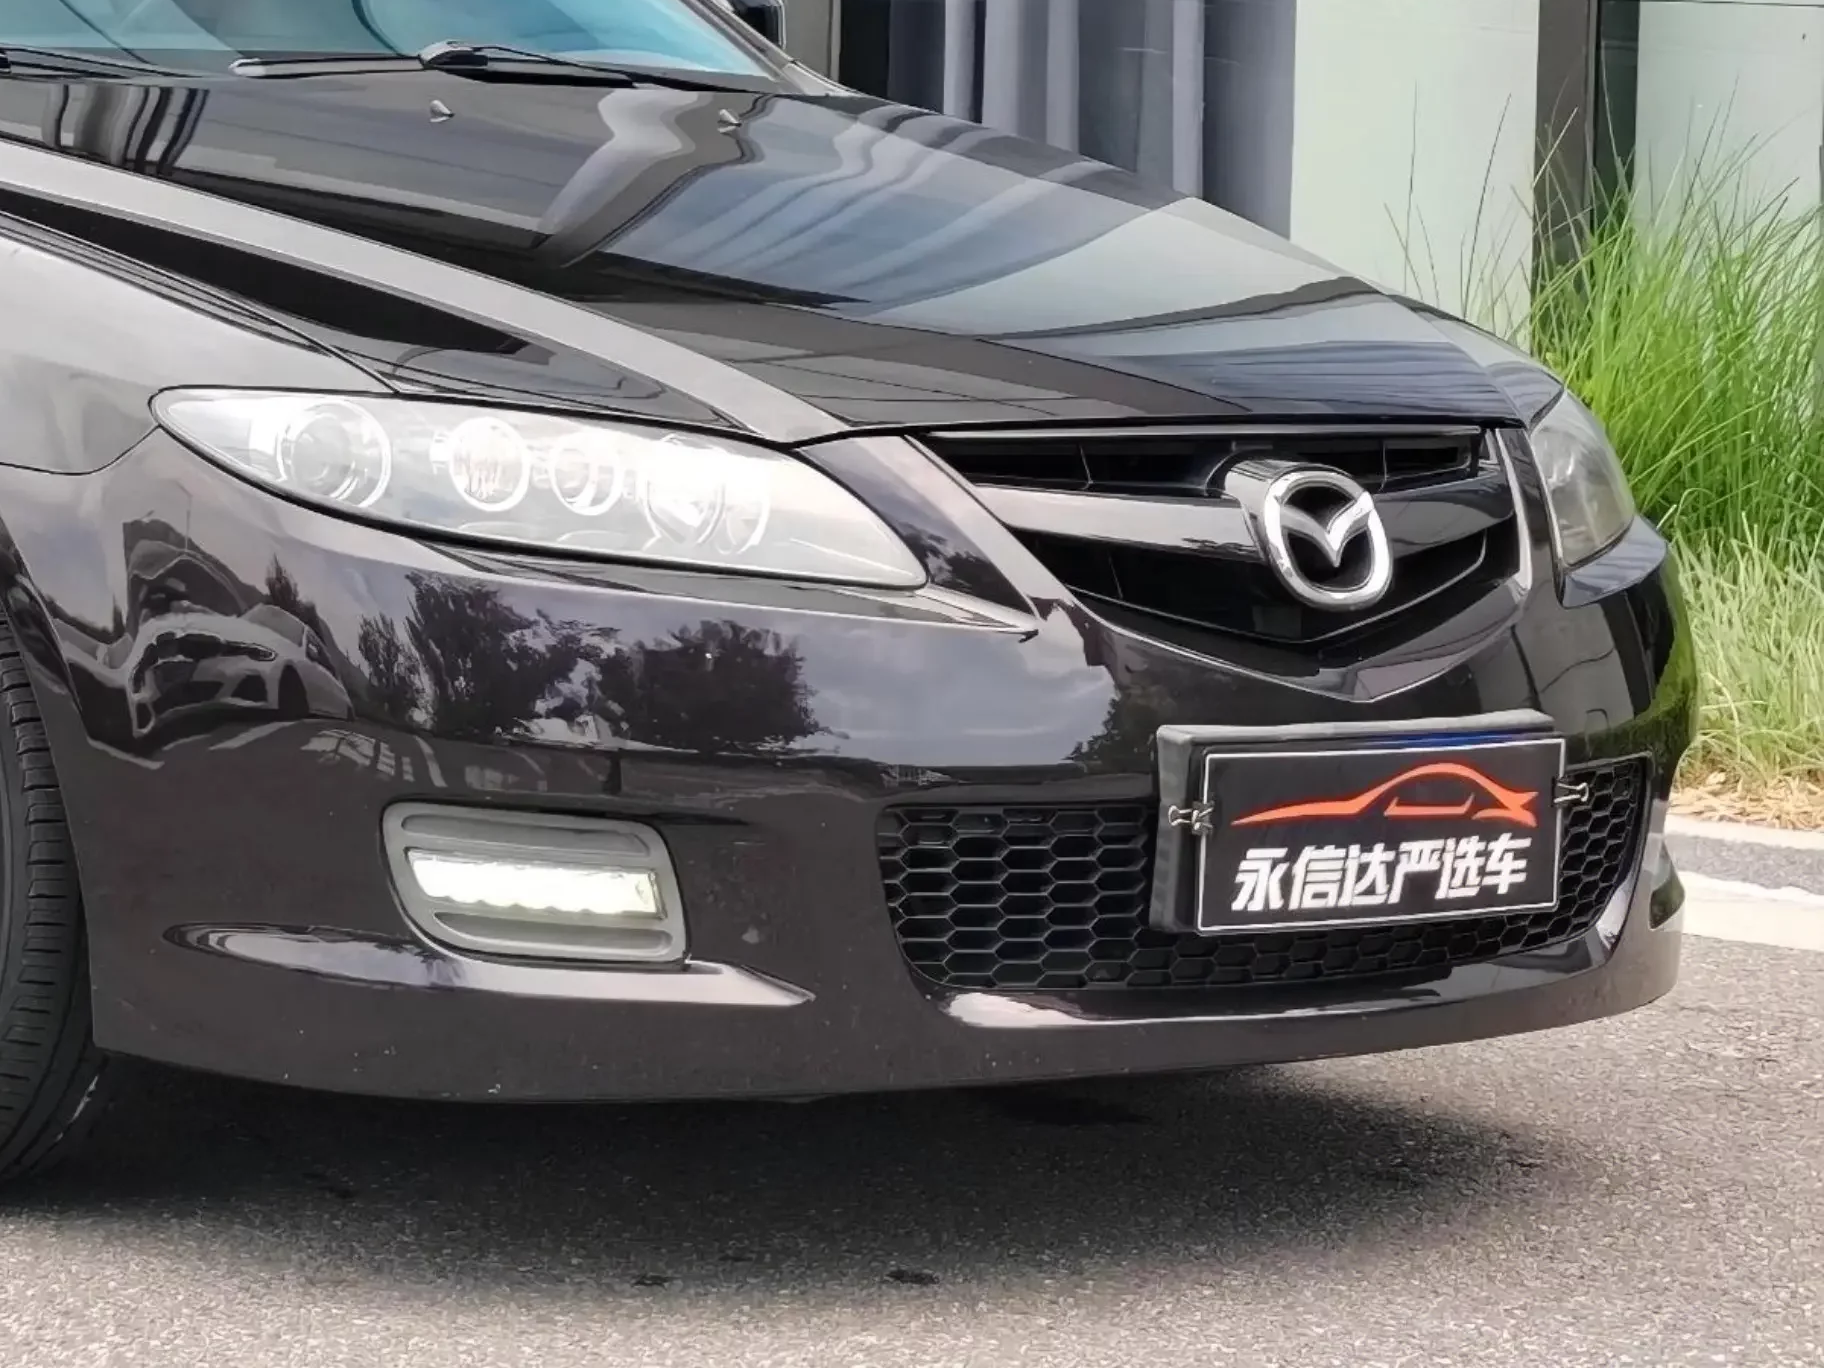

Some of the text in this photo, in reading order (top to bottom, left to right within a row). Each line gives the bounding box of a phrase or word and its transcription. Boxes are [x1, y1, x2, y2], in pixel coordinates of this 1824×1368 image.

[1231, 832, 1532, 912] 永信达严选车
